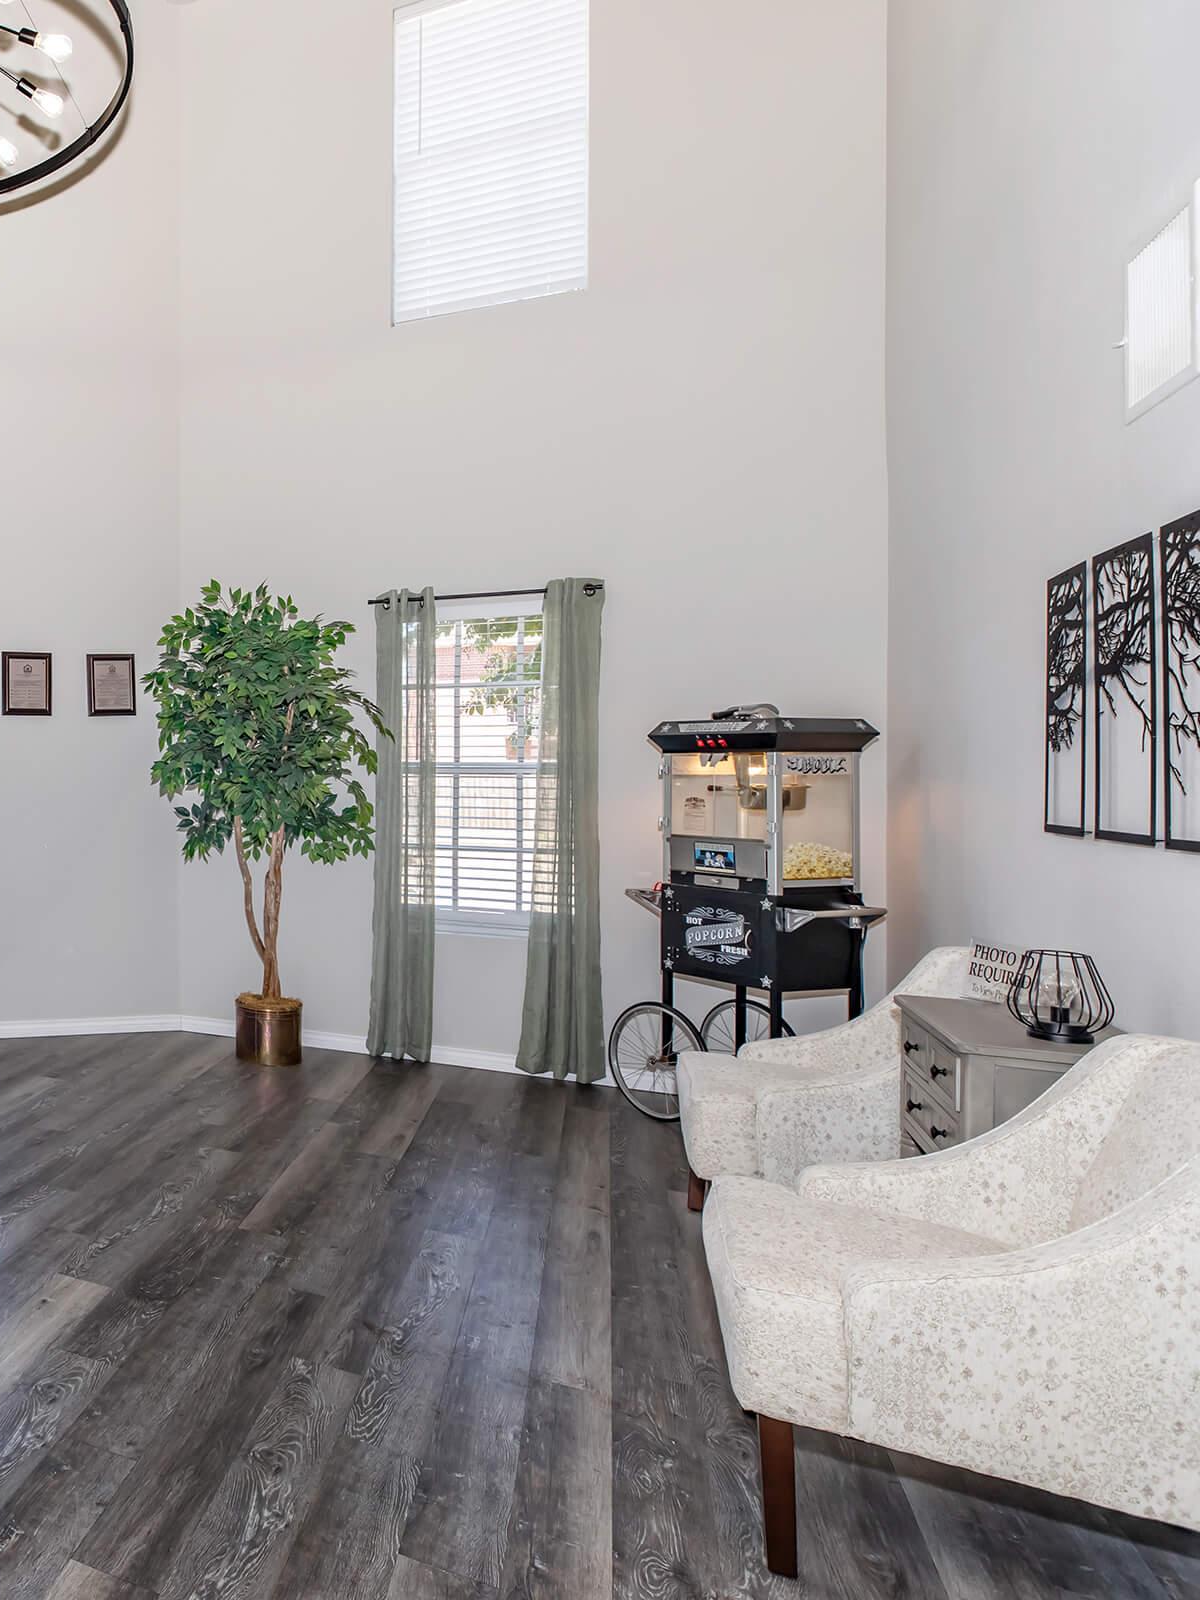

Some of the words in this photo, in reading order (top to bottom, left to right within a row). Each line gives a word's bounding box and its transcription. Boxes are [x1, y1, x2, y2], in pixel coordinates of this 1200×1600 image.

[686, 917, 702, 926] HOT
[688, 927, 742, 943] POPCORN
[721, 945, 748, 956] FRESH
[974, 944, 1016, 966] PHOTO
